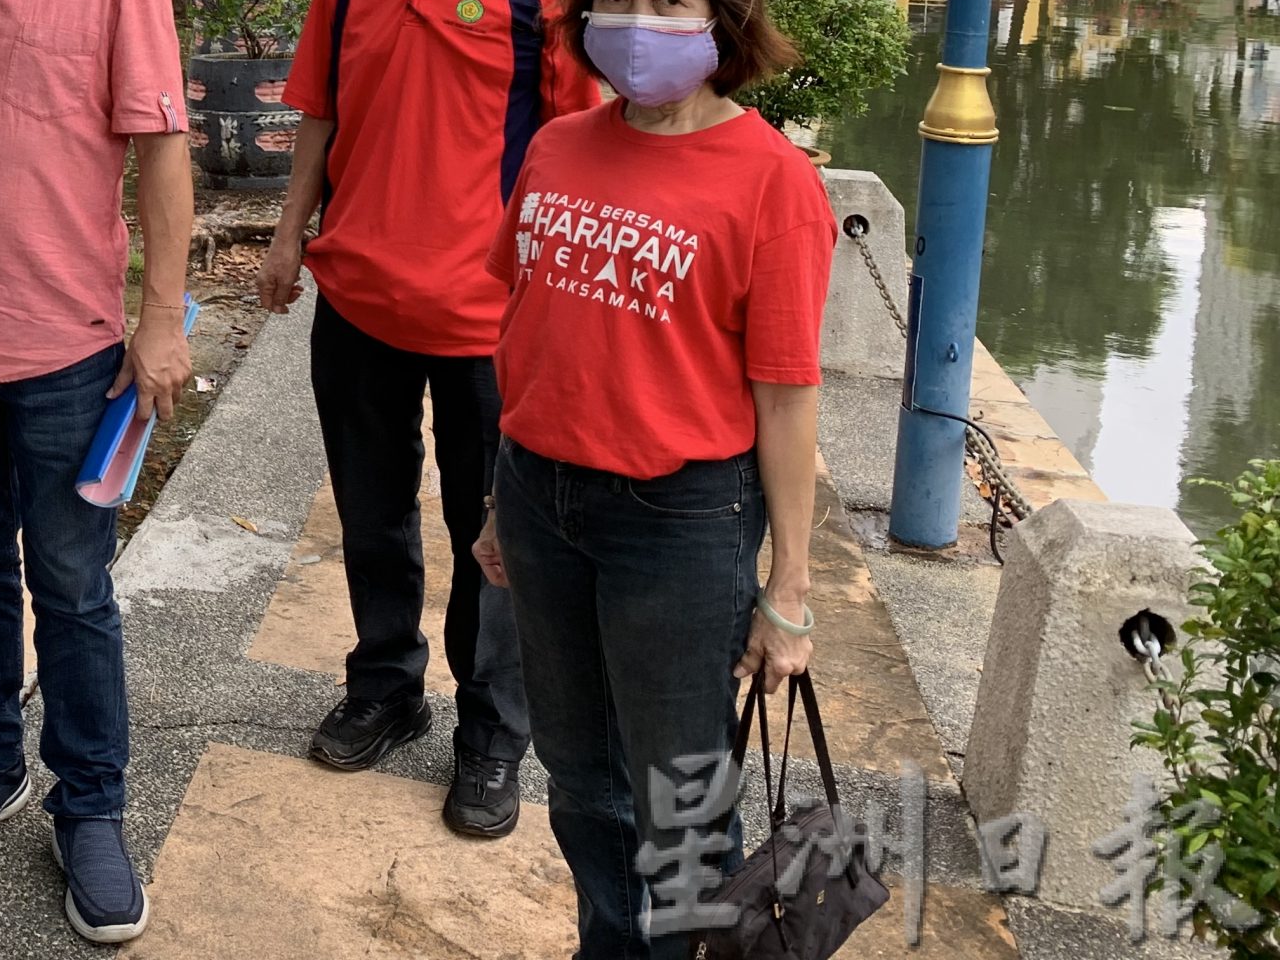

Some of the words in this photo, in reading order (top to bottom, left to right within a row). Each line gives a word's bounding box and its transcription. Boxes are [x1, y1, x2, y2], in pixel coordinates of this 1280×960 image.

[533, 206, 695, 280] HARAPAN
[543, 192, 596, 213] MAJU
[599, 205, 699, 250] BERSAMA
[546, 272, 671, 323] LAKSAMANA
